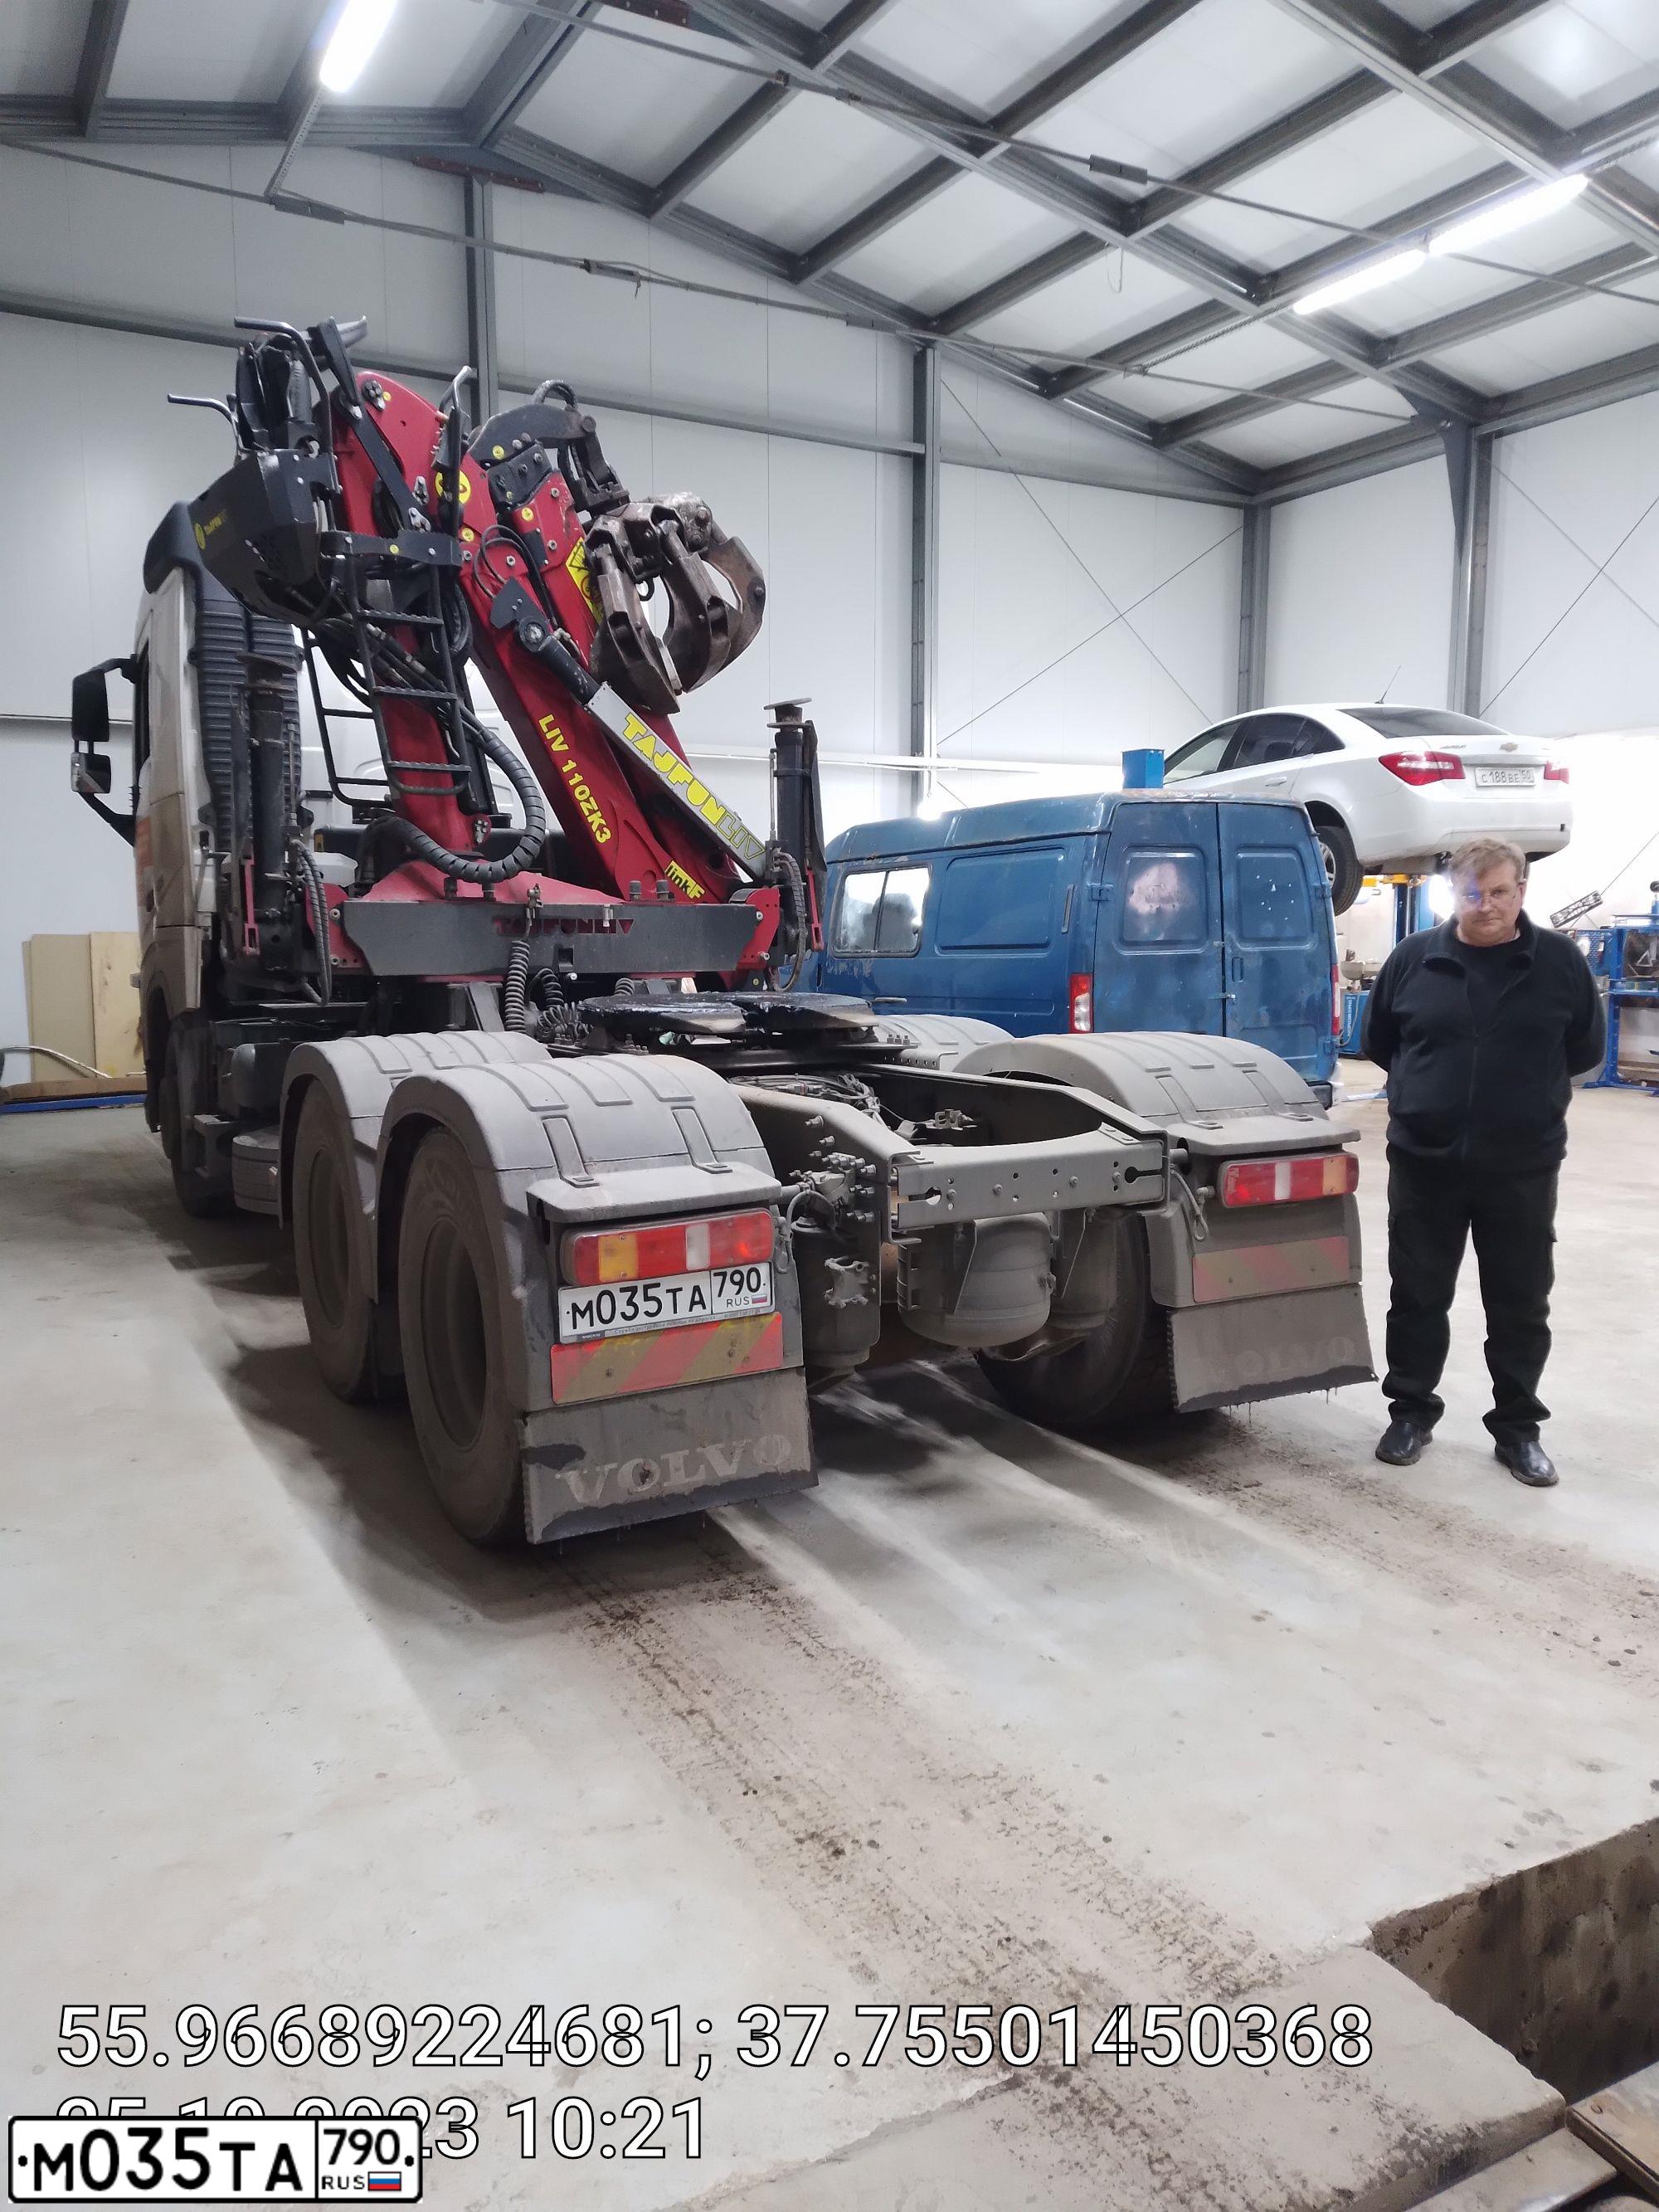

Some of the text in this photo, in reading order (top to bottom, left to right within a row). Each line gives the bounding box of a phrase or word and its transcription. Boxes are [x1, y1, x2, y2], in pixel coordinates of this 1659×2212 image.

[538, 714, 612, 844] LIV 110ZK3
[571, 1267, 761, 1329] М035ТА 790
[726, 1297, 750, 1308] RUS
[556, 1434, 791, 1503] VOLVO
